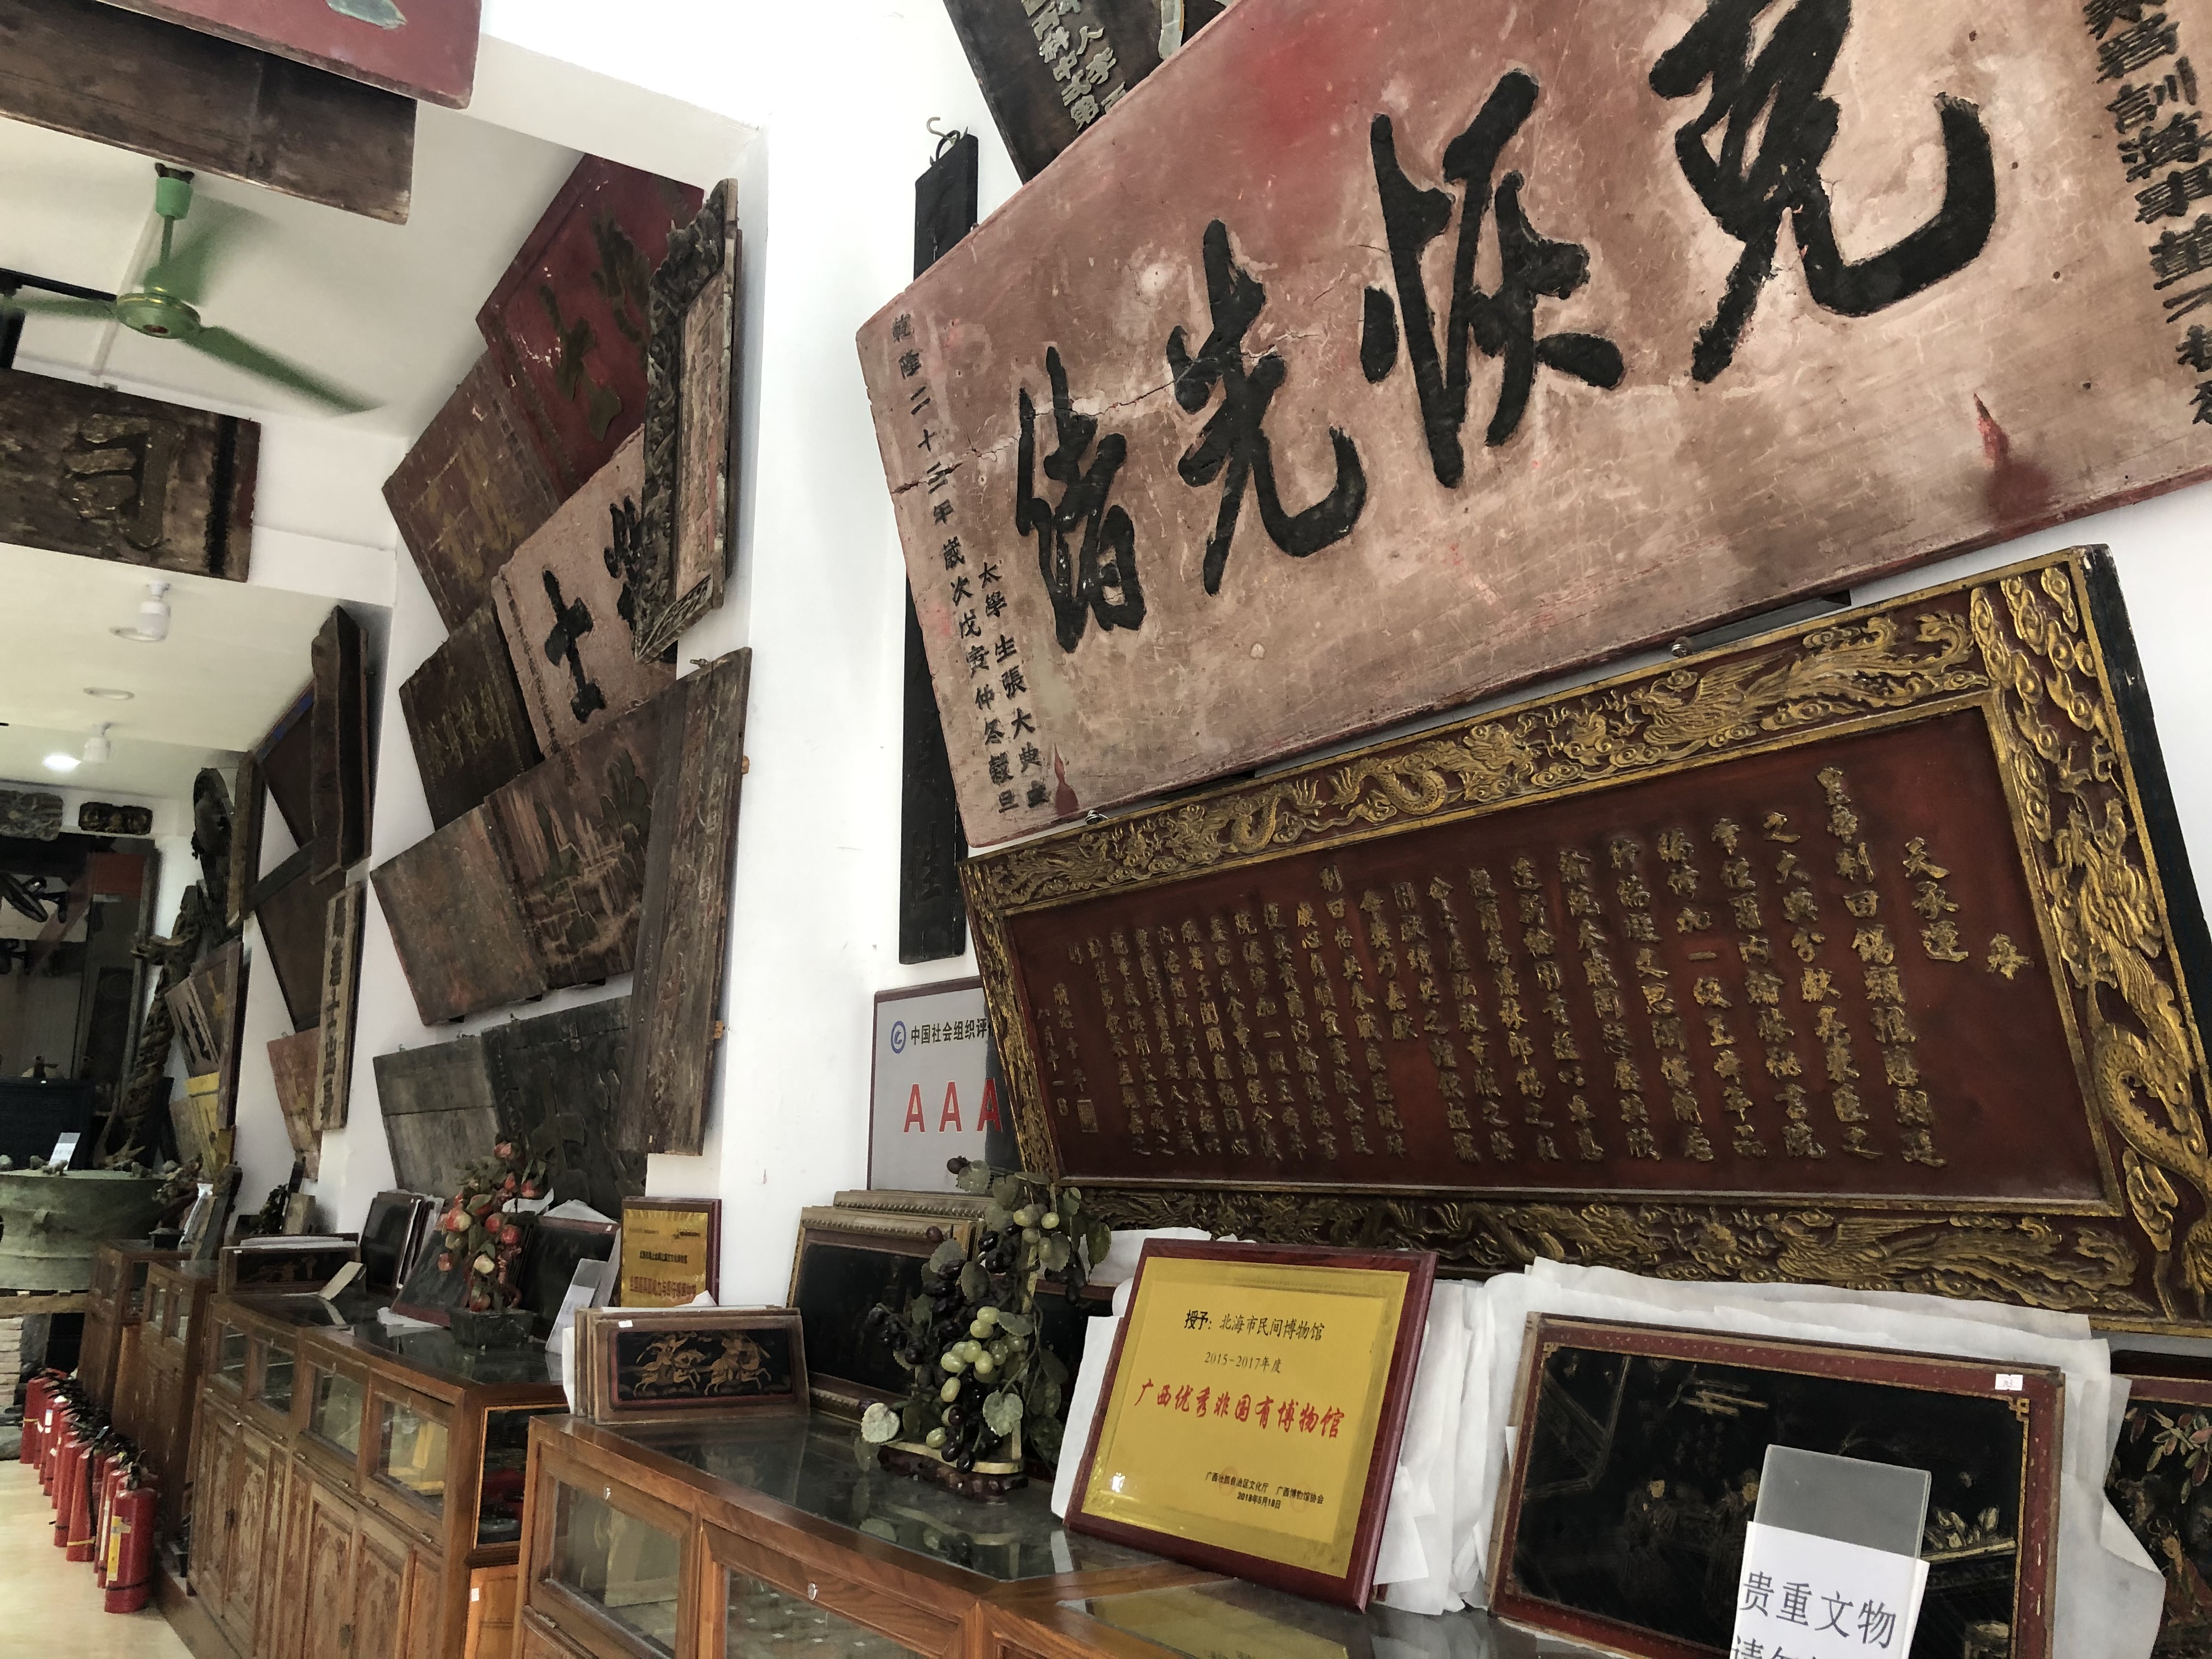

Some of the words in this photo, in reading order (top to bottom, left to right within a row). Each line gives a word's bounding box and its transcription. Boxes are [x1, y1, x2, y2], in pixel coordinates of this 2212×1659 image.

[1901, 836, 1969, 962] 天承運
[1220, 1313, 1325, 1341] 北海市民间博物馆
[1204, 1351, 1283, 1374] 2015-2017年度
[1134, 1378, 1345, 1439] 广西优秀非国有博物馆
[1205, 1471, 1269, 1493] 广西壮族自治区文化厅
[1275, 1486, 1324, 1504] 广西博物馆协会
[1738, 1570, 1897, 1649] 贵重文物
